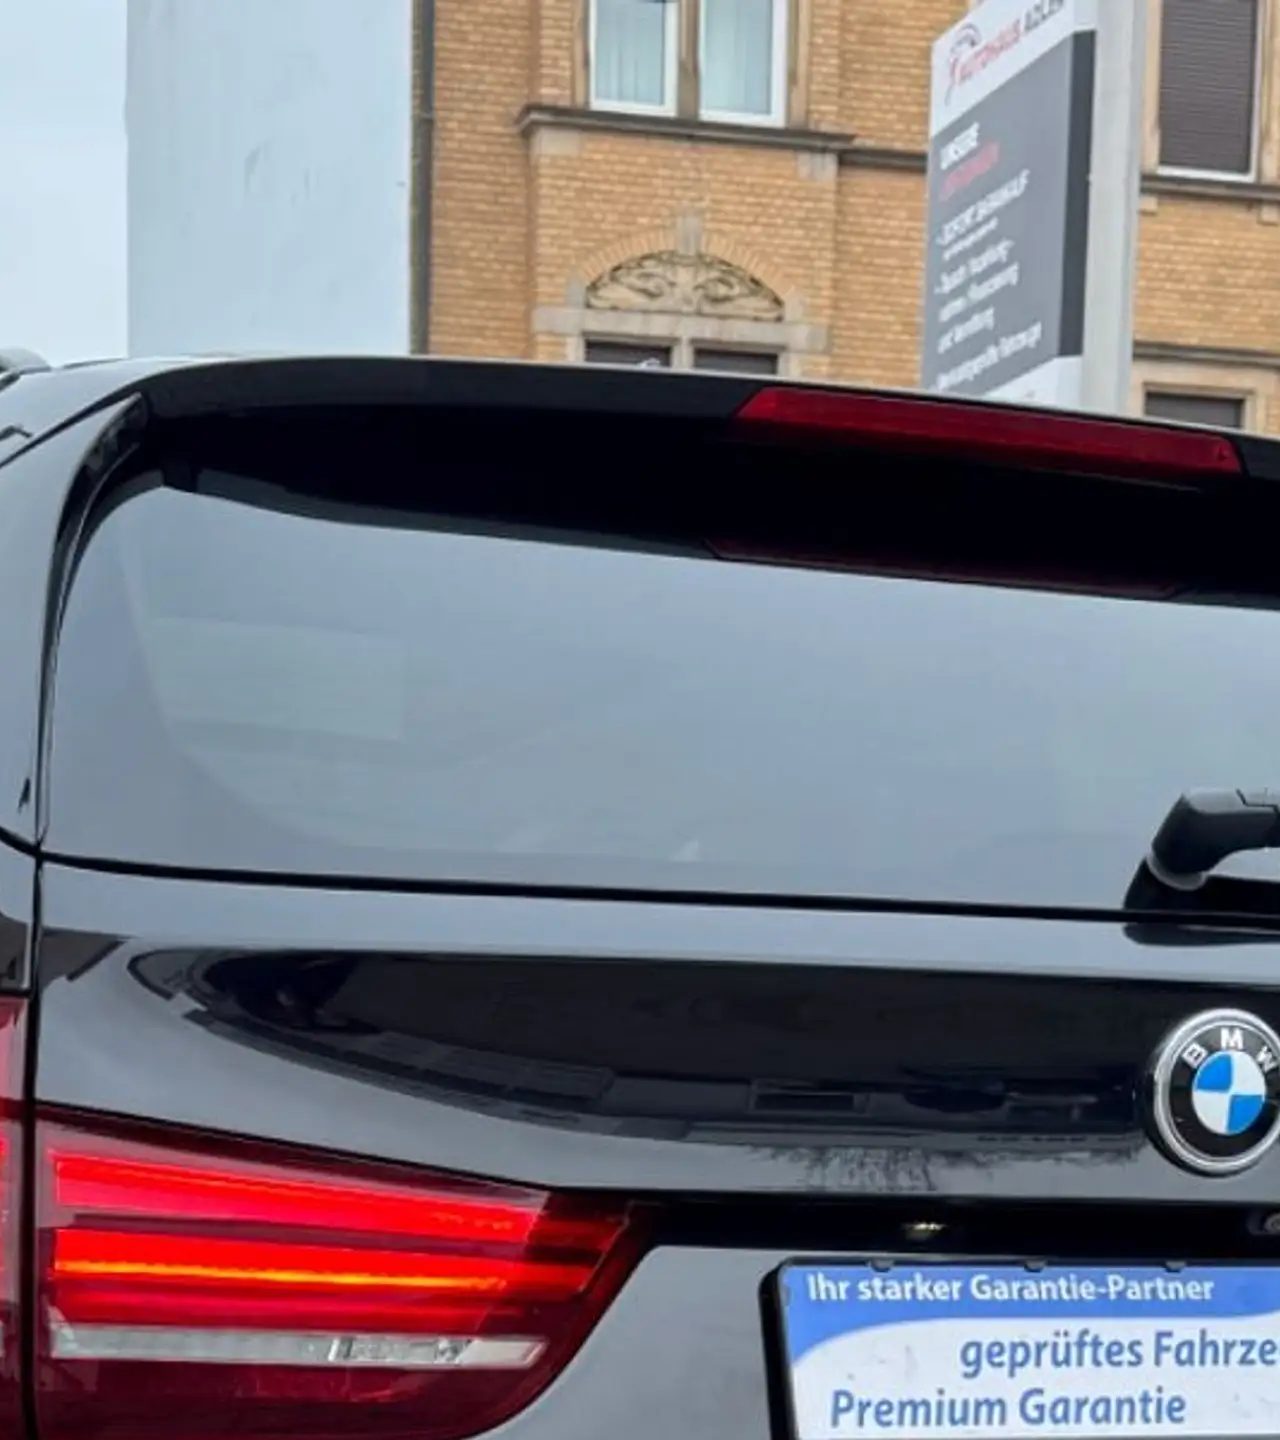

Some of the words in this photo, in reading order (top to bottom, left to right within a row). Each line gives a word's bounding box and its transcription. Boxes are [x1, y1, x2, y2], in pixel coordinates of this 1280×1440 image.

[1181, 1027, 1278, 1074] BMW
[806, 1272, 850, 1302] Ihr
[857, 1271, 963, 1302] starker
[970, 1272, 1216, 1302] Garantie-Partner
[959, 1327, 1145, 1379] geprüftes
[830, 1386, 1008, 1430] Premium
[1018, 1385, 1187, 1426] Garantie
